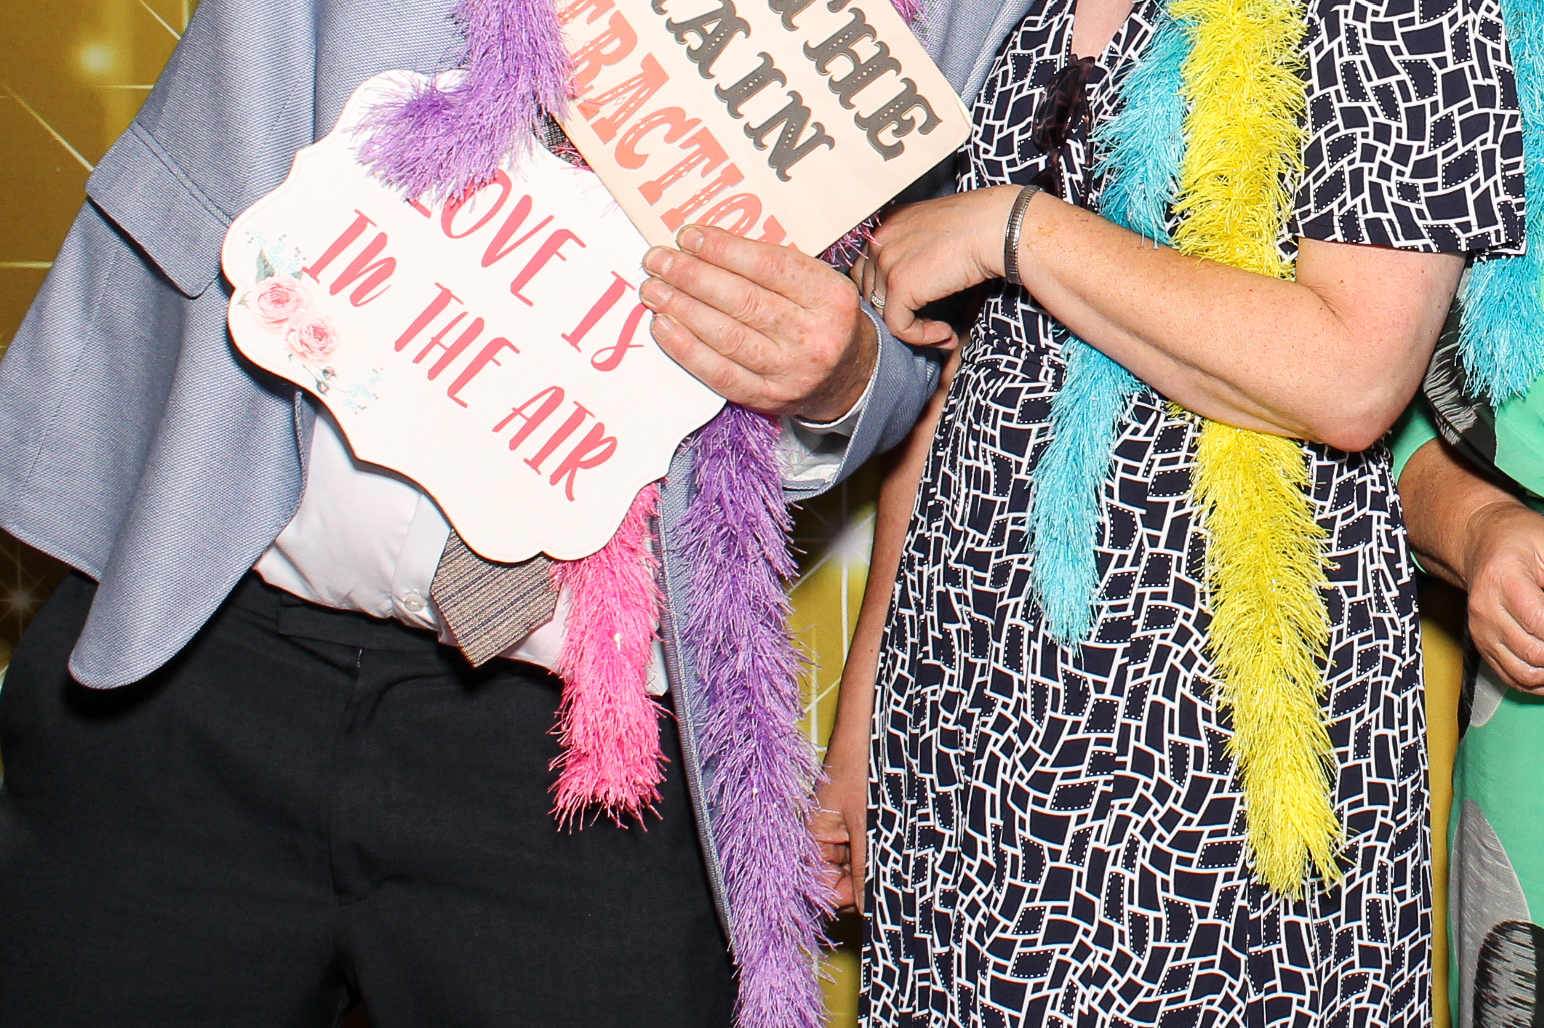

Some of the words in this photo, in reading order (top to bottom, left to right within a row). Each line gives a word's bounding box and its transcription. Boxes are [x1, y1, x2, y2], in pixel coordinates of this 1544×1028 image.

[302, 209, 397, 308] IN
[394, 282, 521, 409] THE
[492, 385, 618, 502] AIR
[561, 270, 650, 373] IS
